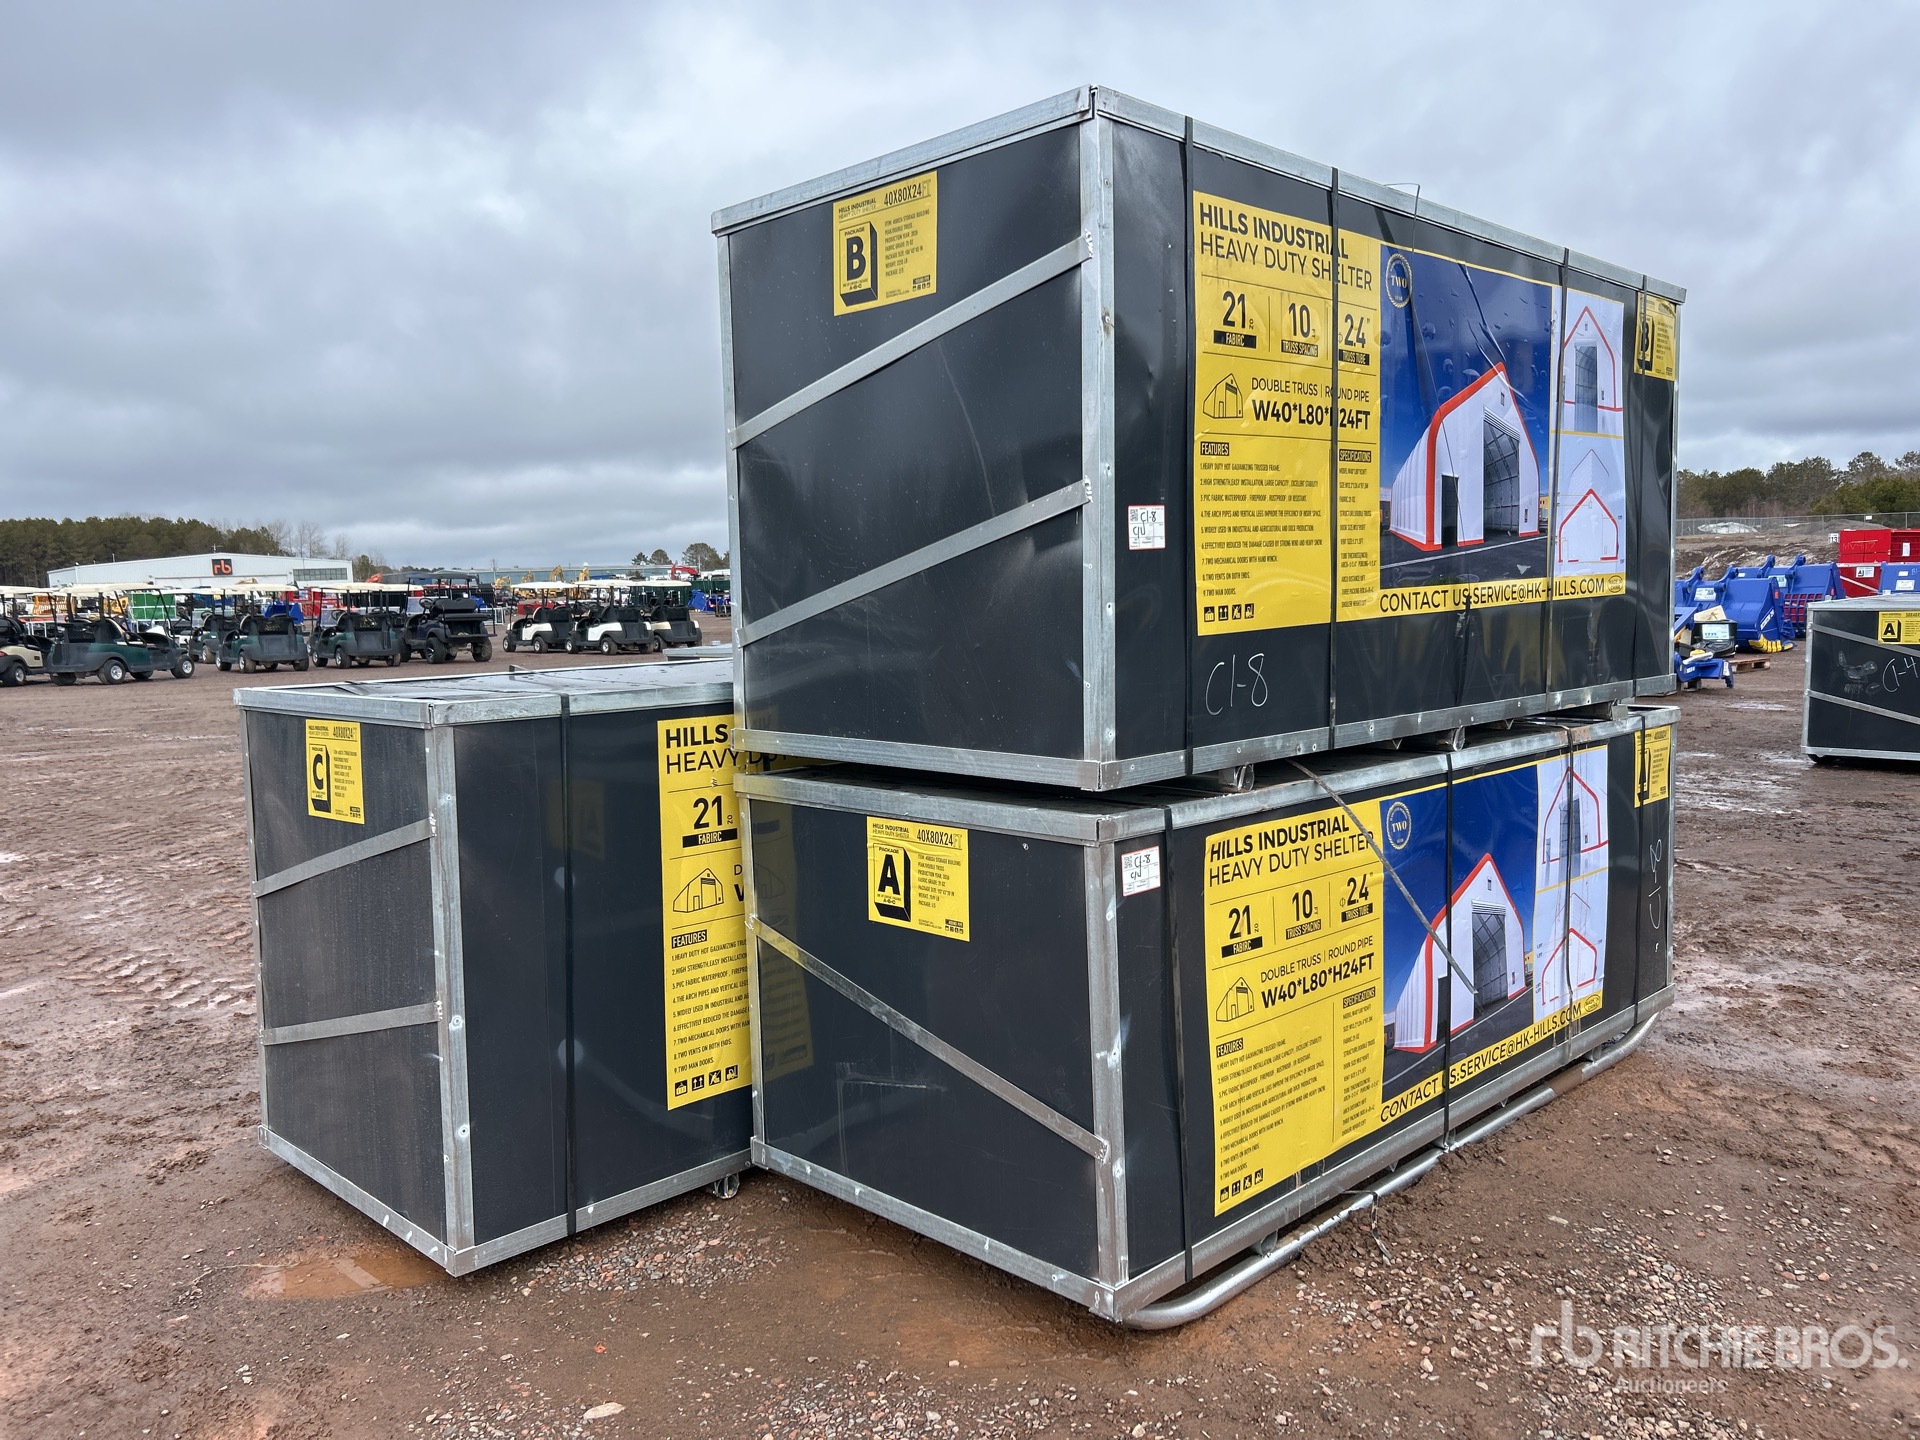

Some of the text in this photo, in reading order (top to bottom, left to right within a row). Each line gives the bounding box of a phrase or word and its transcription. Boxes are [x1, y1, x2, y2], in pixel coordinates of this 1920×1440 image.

[1200, 202, 1248, 235] HILLS
[847, 236, 866, 281] B
[1200, 232, 1258, 265] HEAVY
[1265, 247, 1308, 276] DUTY
[1391, 275, 1407, 288] TWO
[1222, 290, 1246, 329] 21
[1288, 302, 1311, 338] 10
[1252, 377, 1290, 394] DOUBLE
[1292, 383, 1318, 397] TRUSS
[1354, 390, 1369, 403] PIPE
[1201, 443, 1229, 455] FEATURES
[1340, 450, 1370, 462] SPECIFICATIONS
[214, 560, 231, 574] rb
[1380, 589, 1448, 613] CONTACT
[1883, 623, 1895, 635] A
[666, 724, 728, 748] HILLS
[666, 749, 739, 774] HEAVY
[313, 754, 323, 790] C
[693, 796, 722, 830] 21
[885, 825, 909, 833] INDUSTRIAL
[1392, 821, 1407, 832] TWO
[698, 832, 722, 844] FABIRC
[1210, 815, 1349, 863] HILLS INDUSTRIAL
[878, 854, 900, 895] A
[1210, 856, 1263, 887] HEAVY
[1269, 846, 1309, 873] DUTY
[1292, 889, 1312, 922] 10
[1228, 905, 1251, 940] 21
[1287, 920, 1321, 938] TRUSS SPACING
[673, 931, 706, 948] FEATURES
[710, 941, 736, 952] GALVANIZING
[1233, 941, 1251, 954] FABIRC
[1261, 936, 1373, 983] DOUBLE TRUSS ROUND PIPE
[686, 977, 700, 986] FABRIC
[701, 971, 728, 982] WATERPROOF
[686, 992, 697, 1000] ARCH
[698, 989, 710, 997] PIPES
[720, 982, 738, 992] VERTICAL
[1343, 988, 1375, 1008] SPECIFICATIONS
[710, 997, 733, 1008] INDUSTRIAL
[703, 1014, 721, 1024] REDUCED
[688, 1030, 714, 1042] MECHANICAL
[716, 1025, 729, 1034] DOORS
[688, 1047, 700, 1056] VENTS
[709, 1041, 720, 1050] BOTH
[1217, 1039, 1243, 1058] FEATURES
[1380, 1078, 1438, 1123] CONTACT
